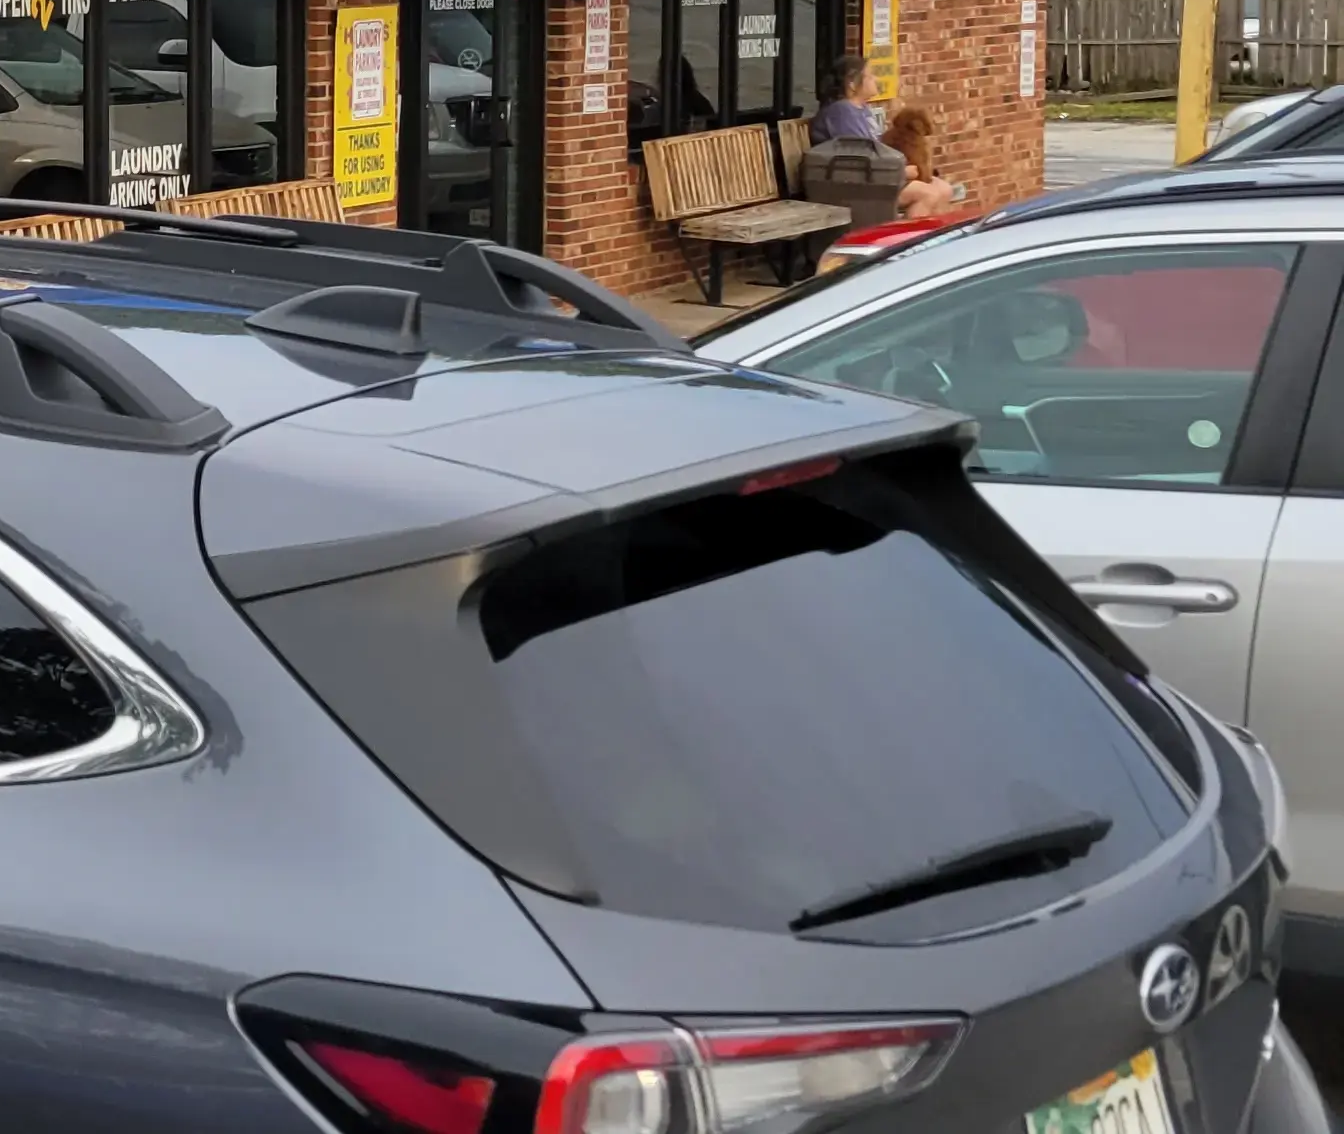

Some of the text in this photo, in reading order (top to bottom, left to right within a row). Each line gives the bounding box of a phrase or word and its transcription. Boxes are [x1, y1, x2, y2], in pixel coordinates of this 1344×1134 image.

[429, 0, 454, 10] PLEASE
[739, 15, 776, 35] LAUNDRY
[349, 132, 380, 151] THANKS
[111, 143, 182, 176] LAUNDRY
[344, 154, 384, 175] FOR USING
[109, 174, 190, 208] ARKING ONLY
[355, 176, 391, 197] LAUNDRY
